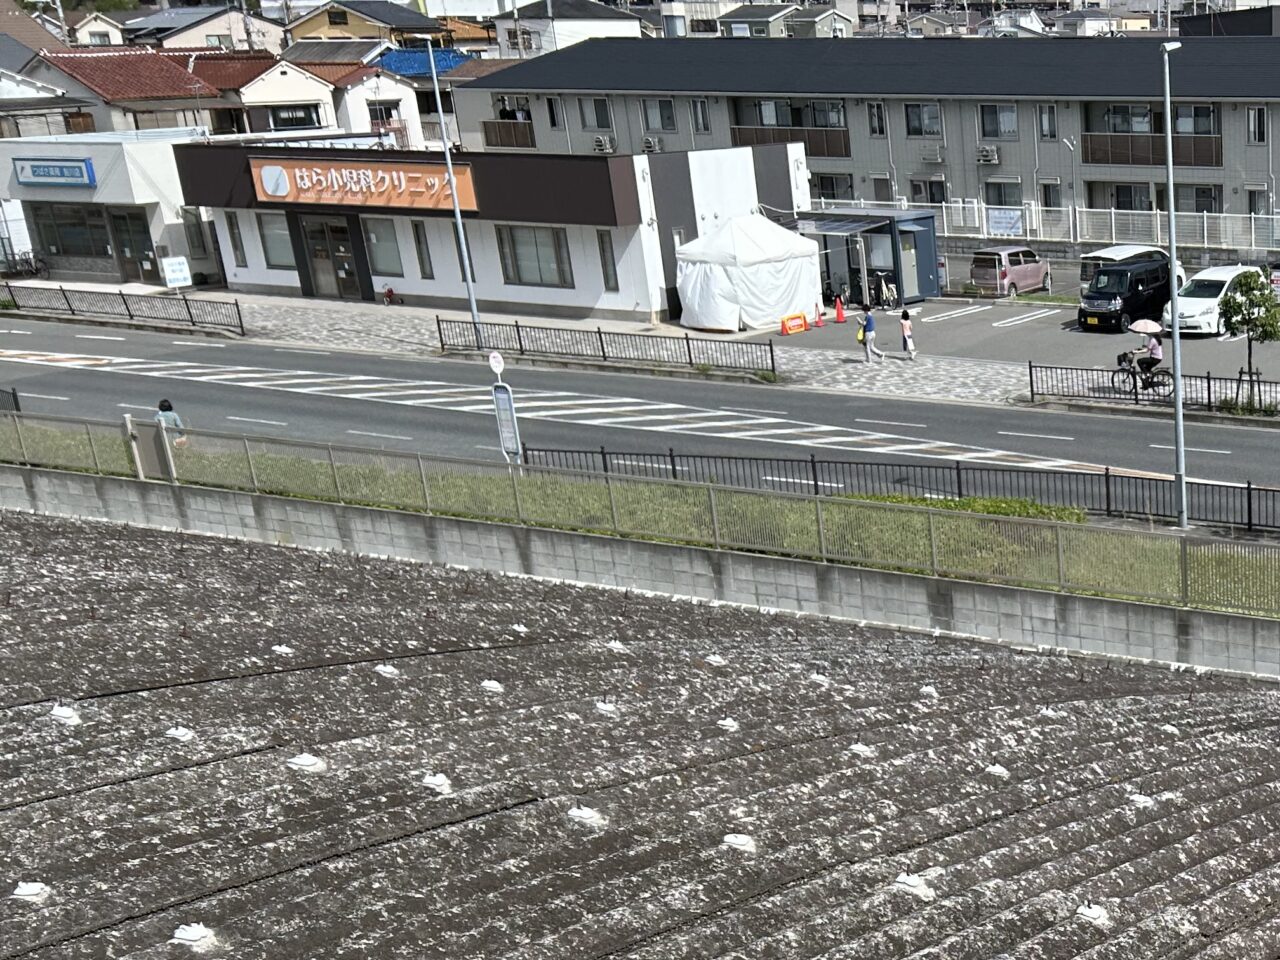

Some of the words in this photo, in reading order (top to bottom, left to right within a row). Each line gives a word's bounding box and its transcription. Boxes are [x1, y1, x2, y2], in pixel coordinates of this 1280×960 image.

[295, 167, 457, 195] はら小児科クリニック
